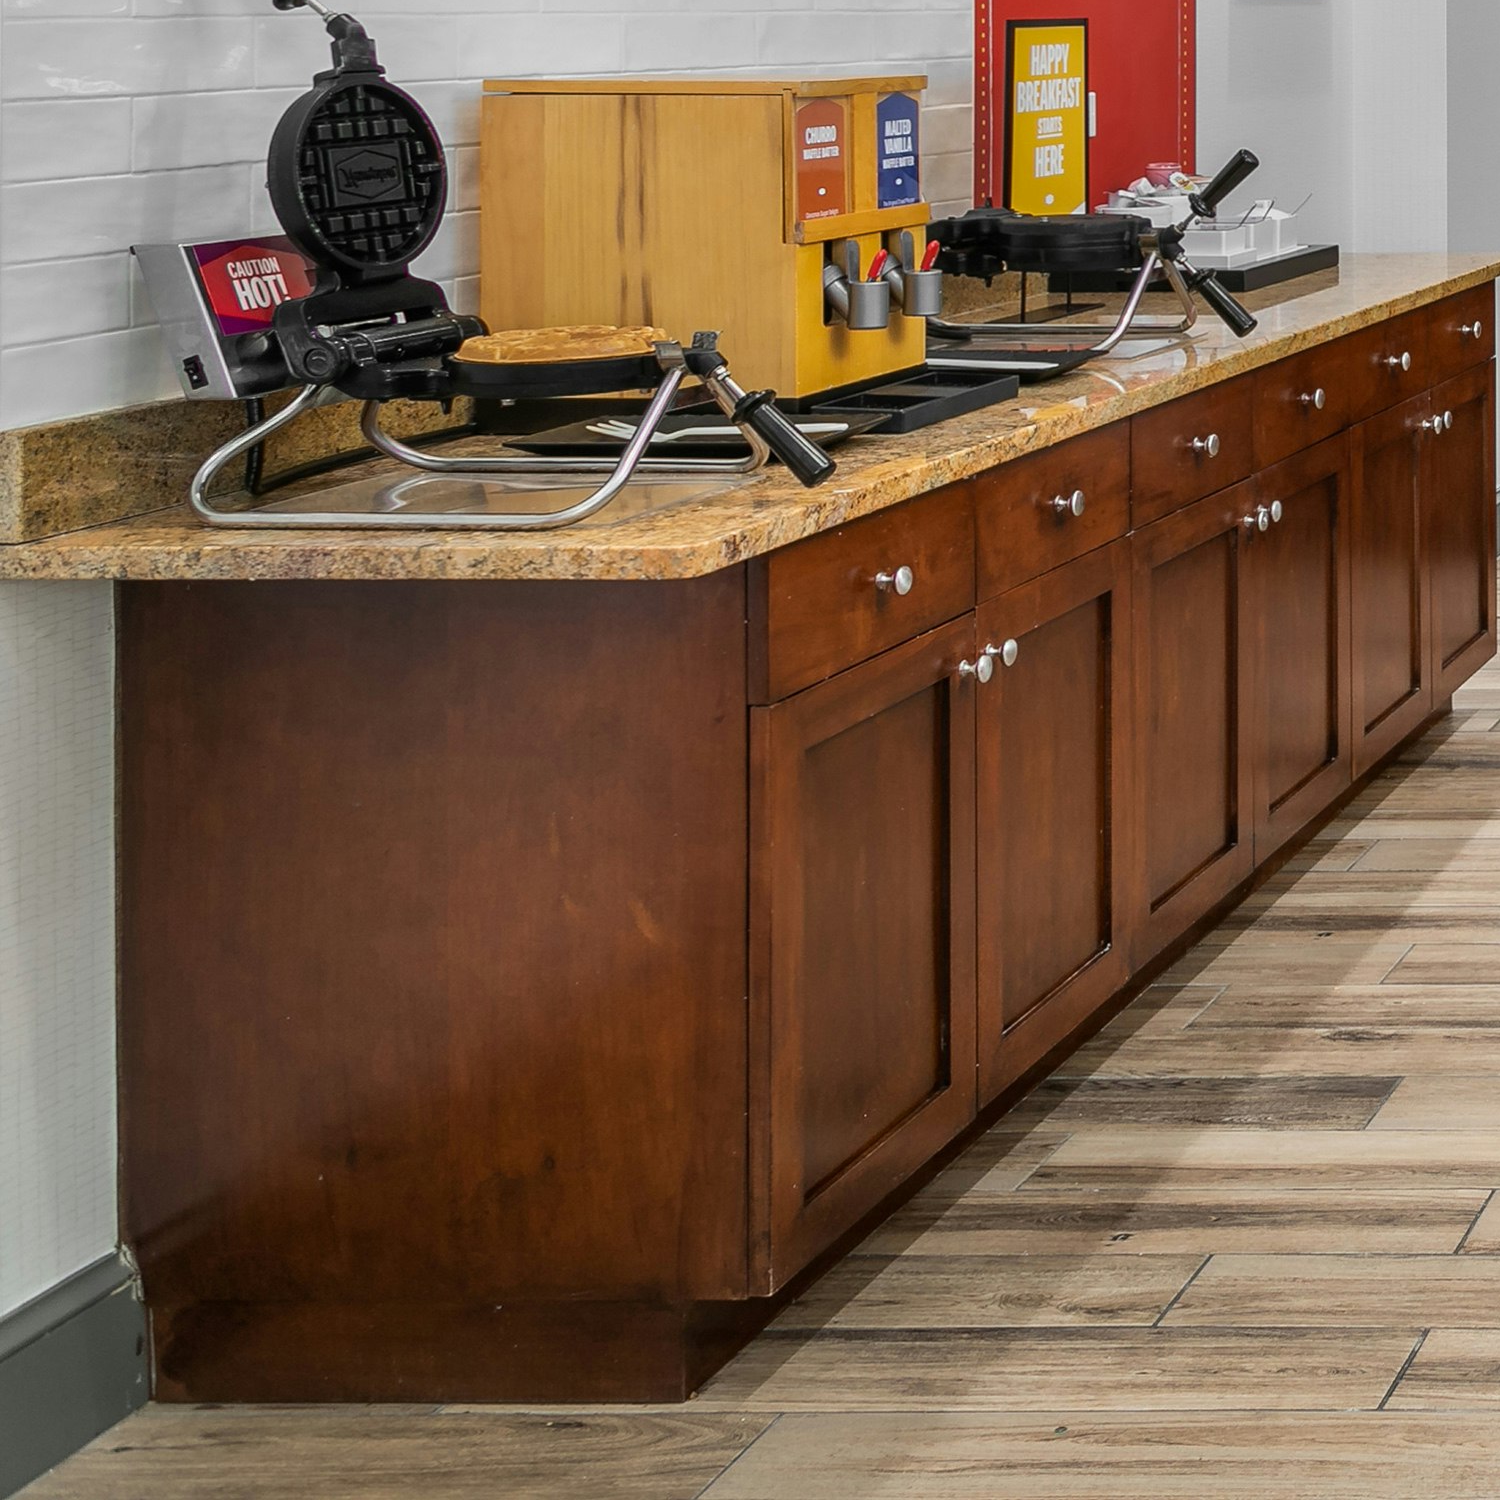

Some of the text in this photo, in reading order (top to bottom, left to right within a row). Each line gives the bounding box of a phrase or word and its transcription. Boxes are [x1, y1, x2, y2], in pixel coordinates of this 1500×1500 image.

[1030, 43, 1069, 76] HAPPY
[1016, 77, 1081, 113] BREAKFAST
[805, 125, 837, 145] CHURRO
[884, 118, 912, 137] MALTED
[1037, 116, 1063, 134] STARTS
[884, 136, 913, 155] VANILLA
[1034, 144, 1065, 178] HERE
[226, 256, 281, 279] CAUTION
[232, 273, 292, 311] HOT!
